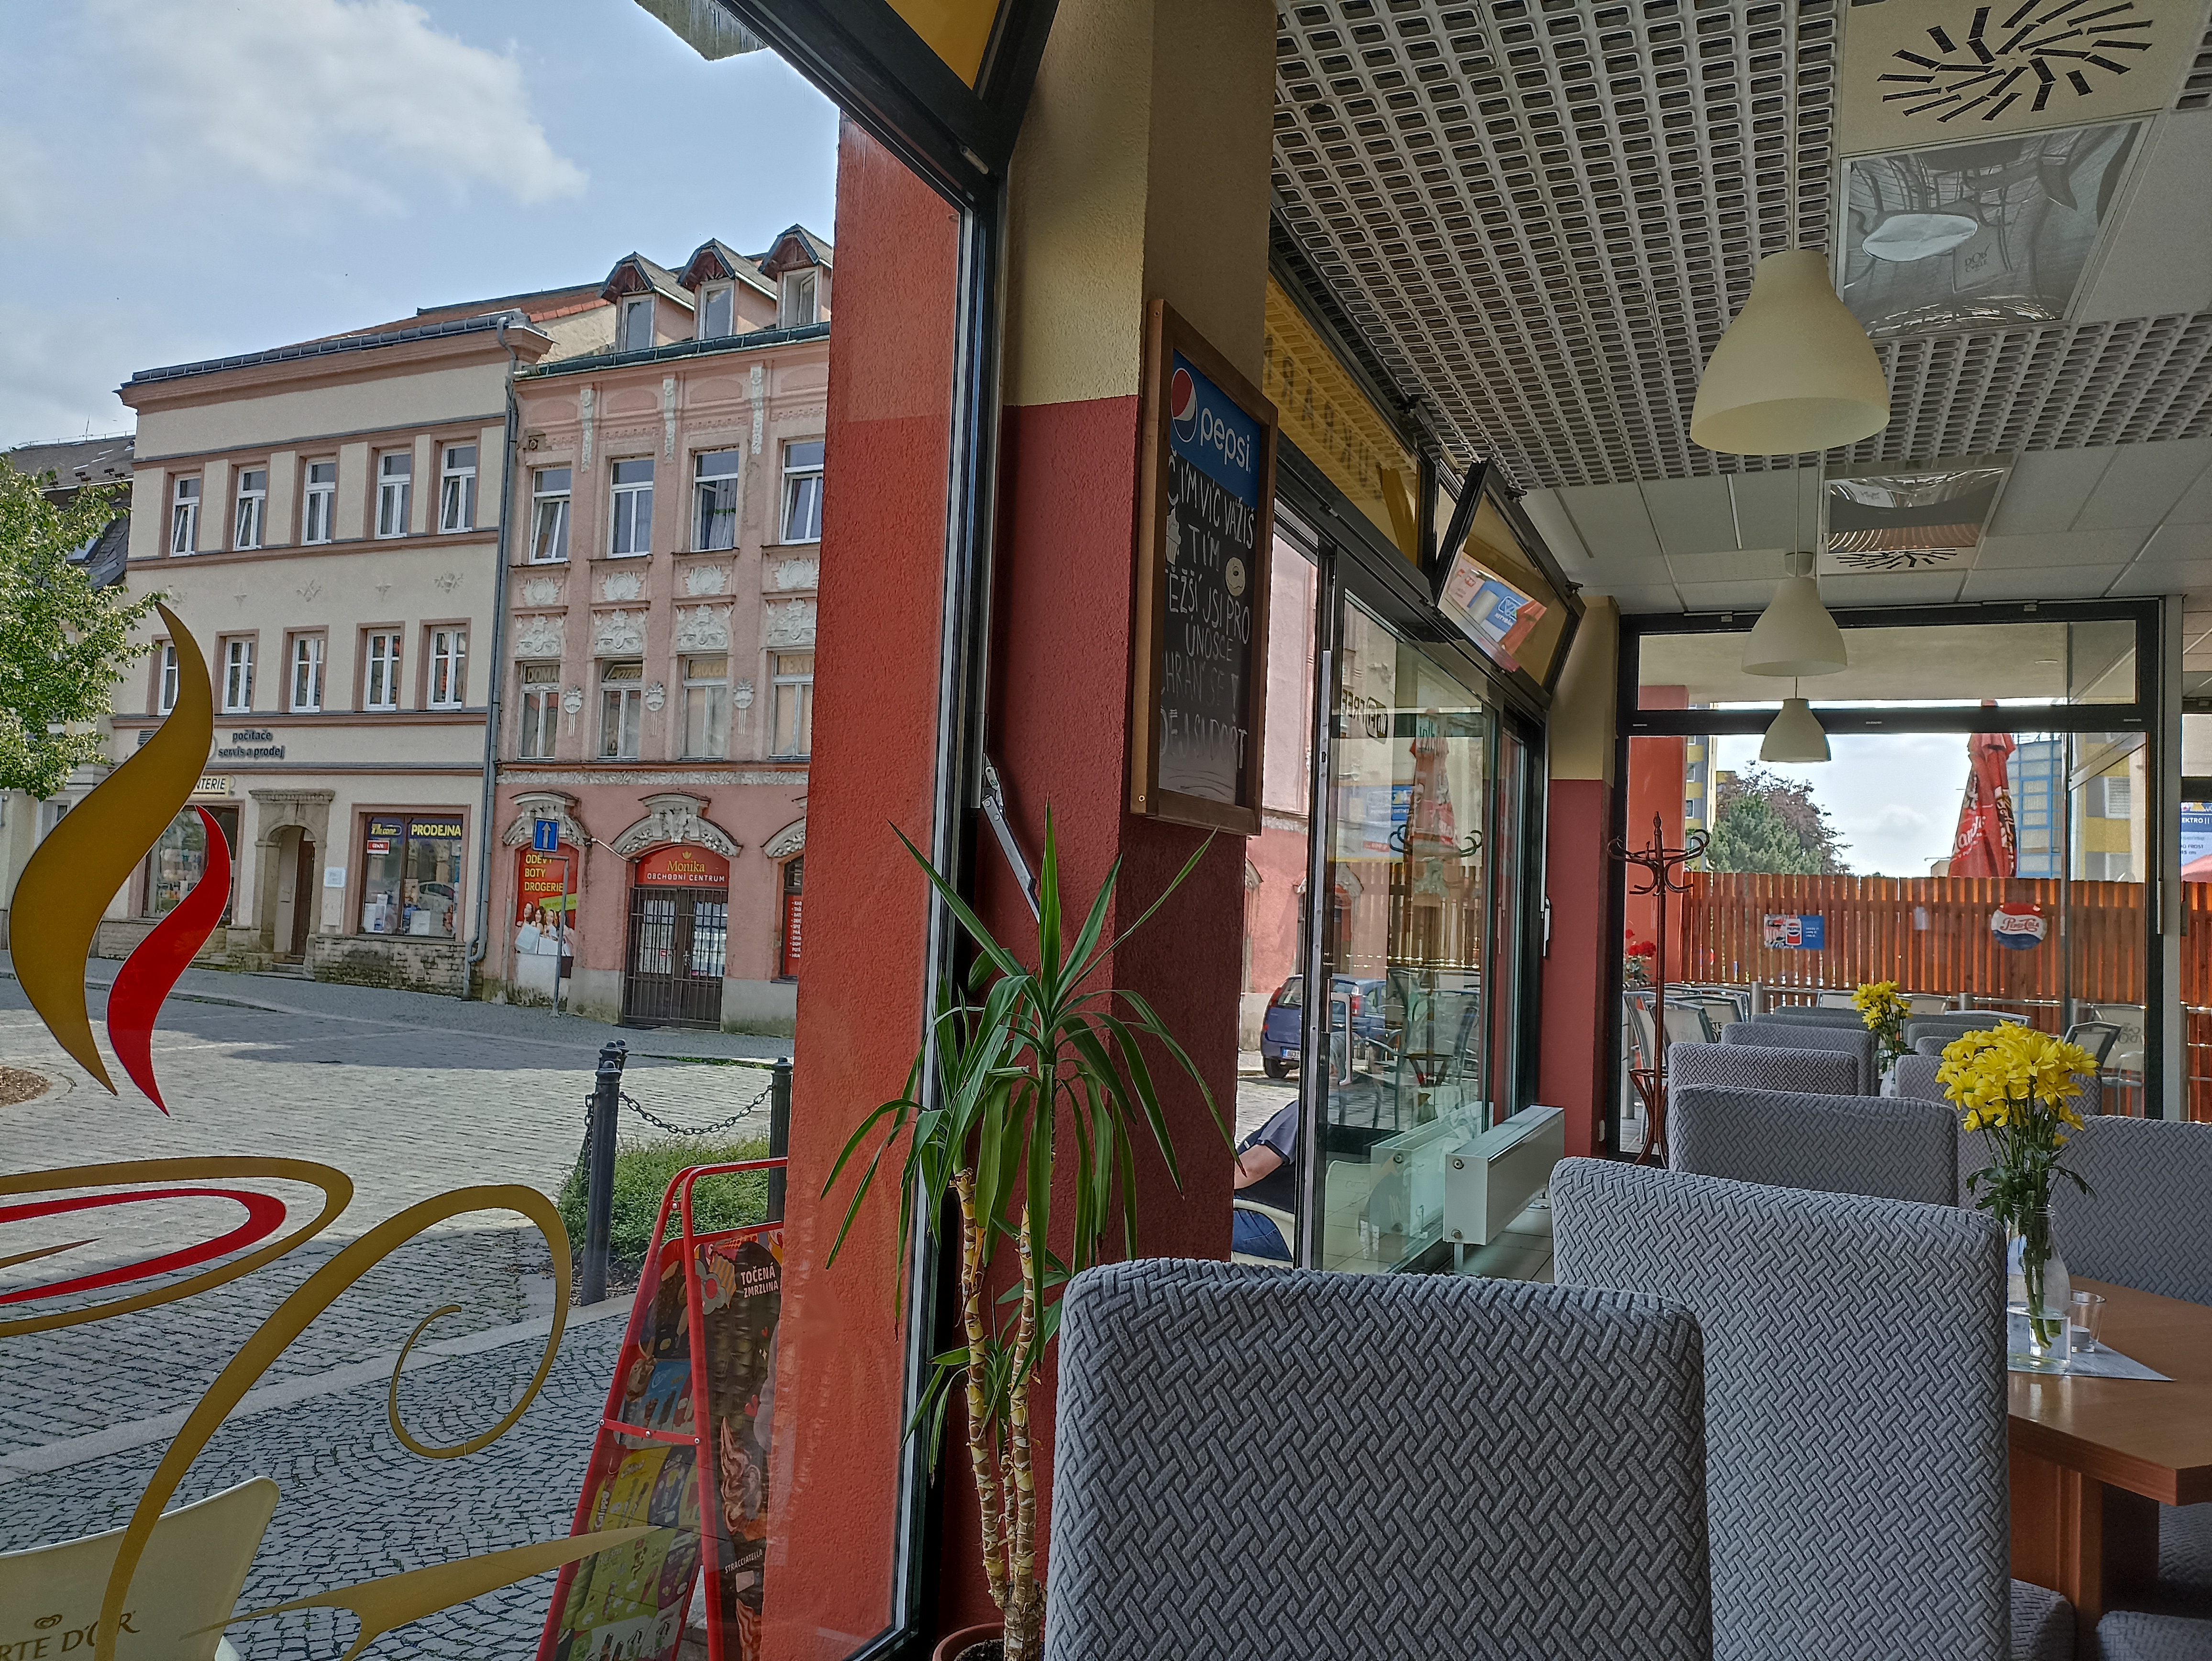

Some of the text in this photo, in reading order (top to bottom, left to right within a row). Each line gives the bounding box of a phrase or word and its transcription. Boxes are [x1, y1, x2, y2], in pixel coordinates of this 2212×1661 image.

[1200, 408, 1250, 472] pepsi
[1201, 477, 1220, 527] VÍC
[1188, 524, 1220, 572] TÍM
[1165, 566, 1250, 644] ĚŽŠÍ JSI PRO
[1186, 615, 1233, 661] ÚNOSCE
[1161, 651, 1206, 702] HRAŇ
[218, 746, 244, 757] servis
[254, 745, 286, 759] prodej
[411, 824, 462, 836] PRODEJNA
[525, 868, 546, 878] BOTY
[647, 872, 686, 880] OBCHODNÍ
[667, 860, 705, 872] Monika
[524, 881, 564, 892] DROGERIE
[741, 1262, 775, 1285] TOČENÁ
[744, 1280, 779, 1298] ZMRZLINA
[595, 1490, 610, 1528] Calippo
[725, 1549, 763, 1574] STRACCIATELLA
